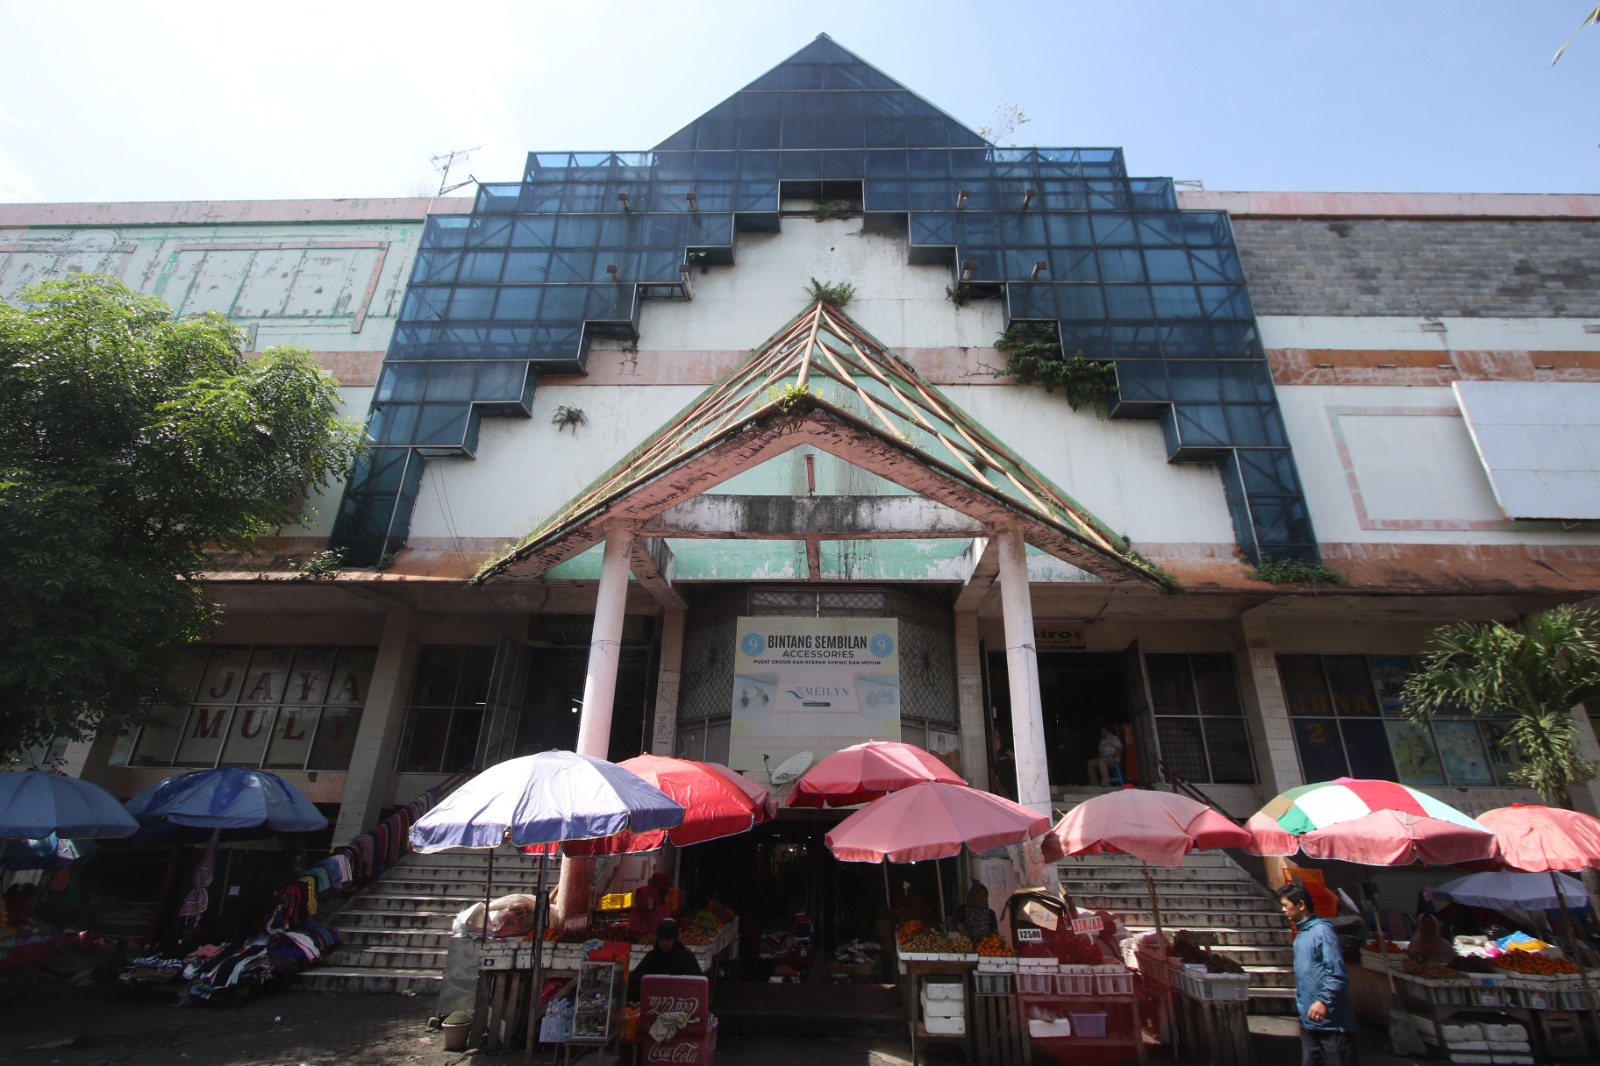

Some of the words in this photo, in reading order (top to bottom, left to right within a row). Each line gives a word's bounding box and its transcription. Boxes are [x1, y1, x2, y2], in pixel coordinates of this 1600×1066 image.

[767, 635, 812, 649] BINTANG
[814, 635, 867, 650] SEMBILAN
[782, 650, 855, 658] ACCESSORIES
[209, 671, 360, 701] JAYA
[1291, 691, 1374, 714] JUNA
[191, 709, 352, 741] MULY
[1306, 722, 1326, 744] 2
[1018, 930, 1041, 939] 12500
